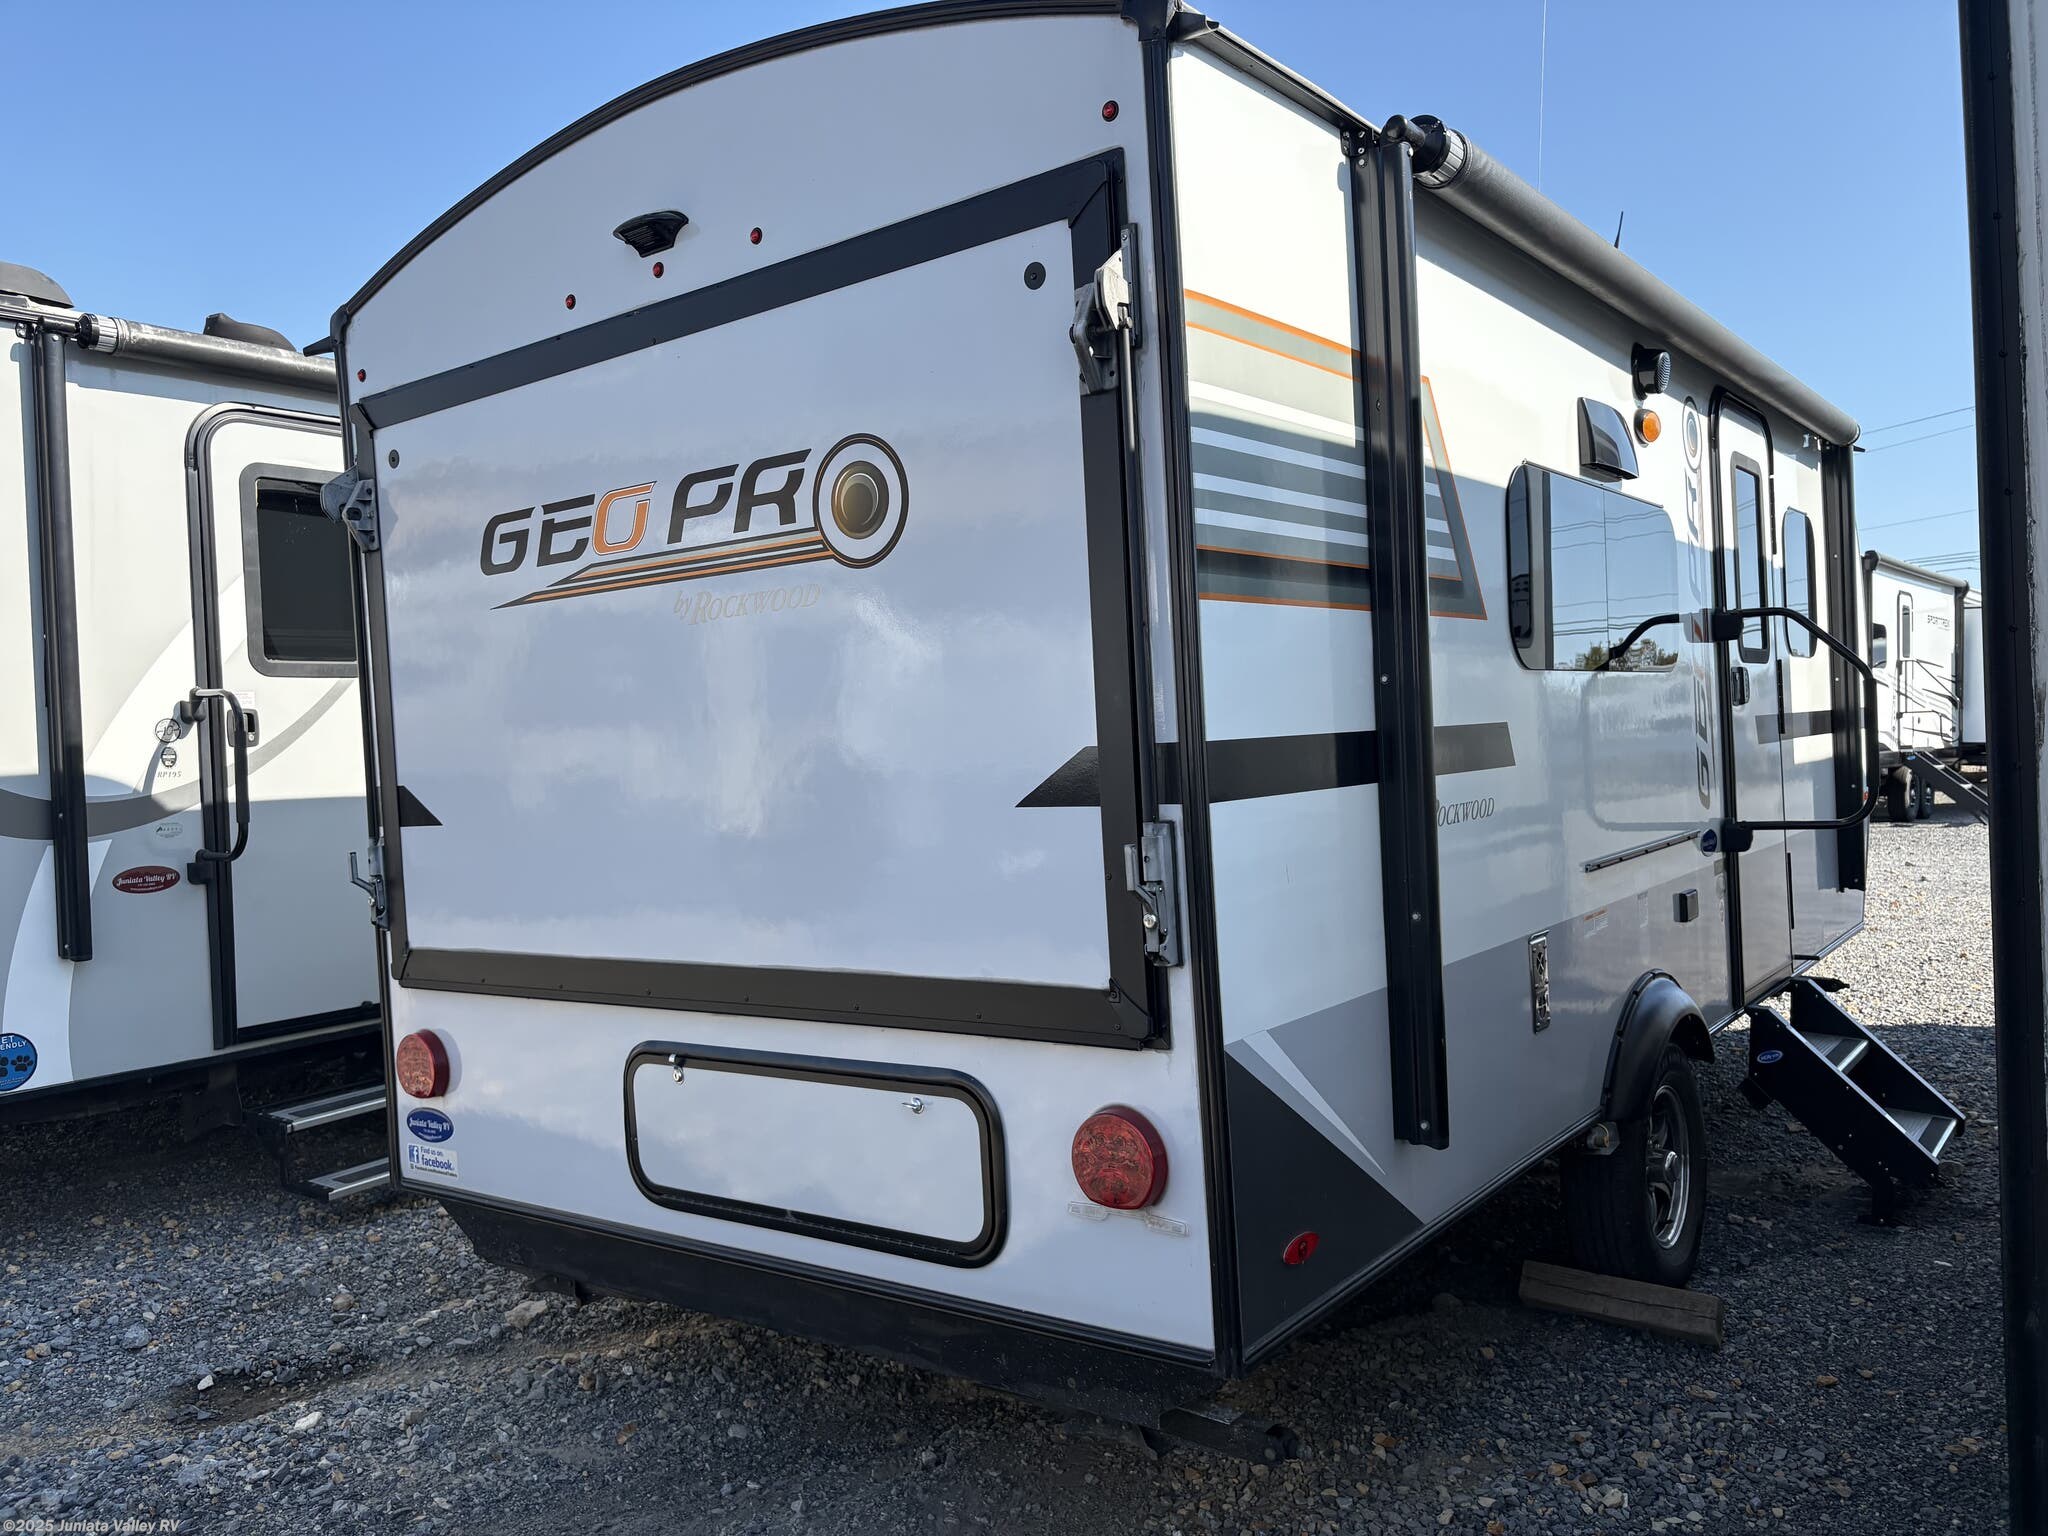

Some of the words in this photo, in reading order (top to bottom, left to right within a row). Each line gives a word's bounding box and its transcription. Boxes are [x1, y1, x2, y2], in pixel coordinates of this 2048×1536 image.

[480, 480, 658, 576] GEO
[666, 432, 910, 570] PRO
[673, 590, 693, 621] by
[688, 583, 824, 626] ROCKWOOD
[143, 874, 166, 883] Valley
[1, 1035, 14, 1043] ET
[0, 1040, 27, 1050] ENDLY
